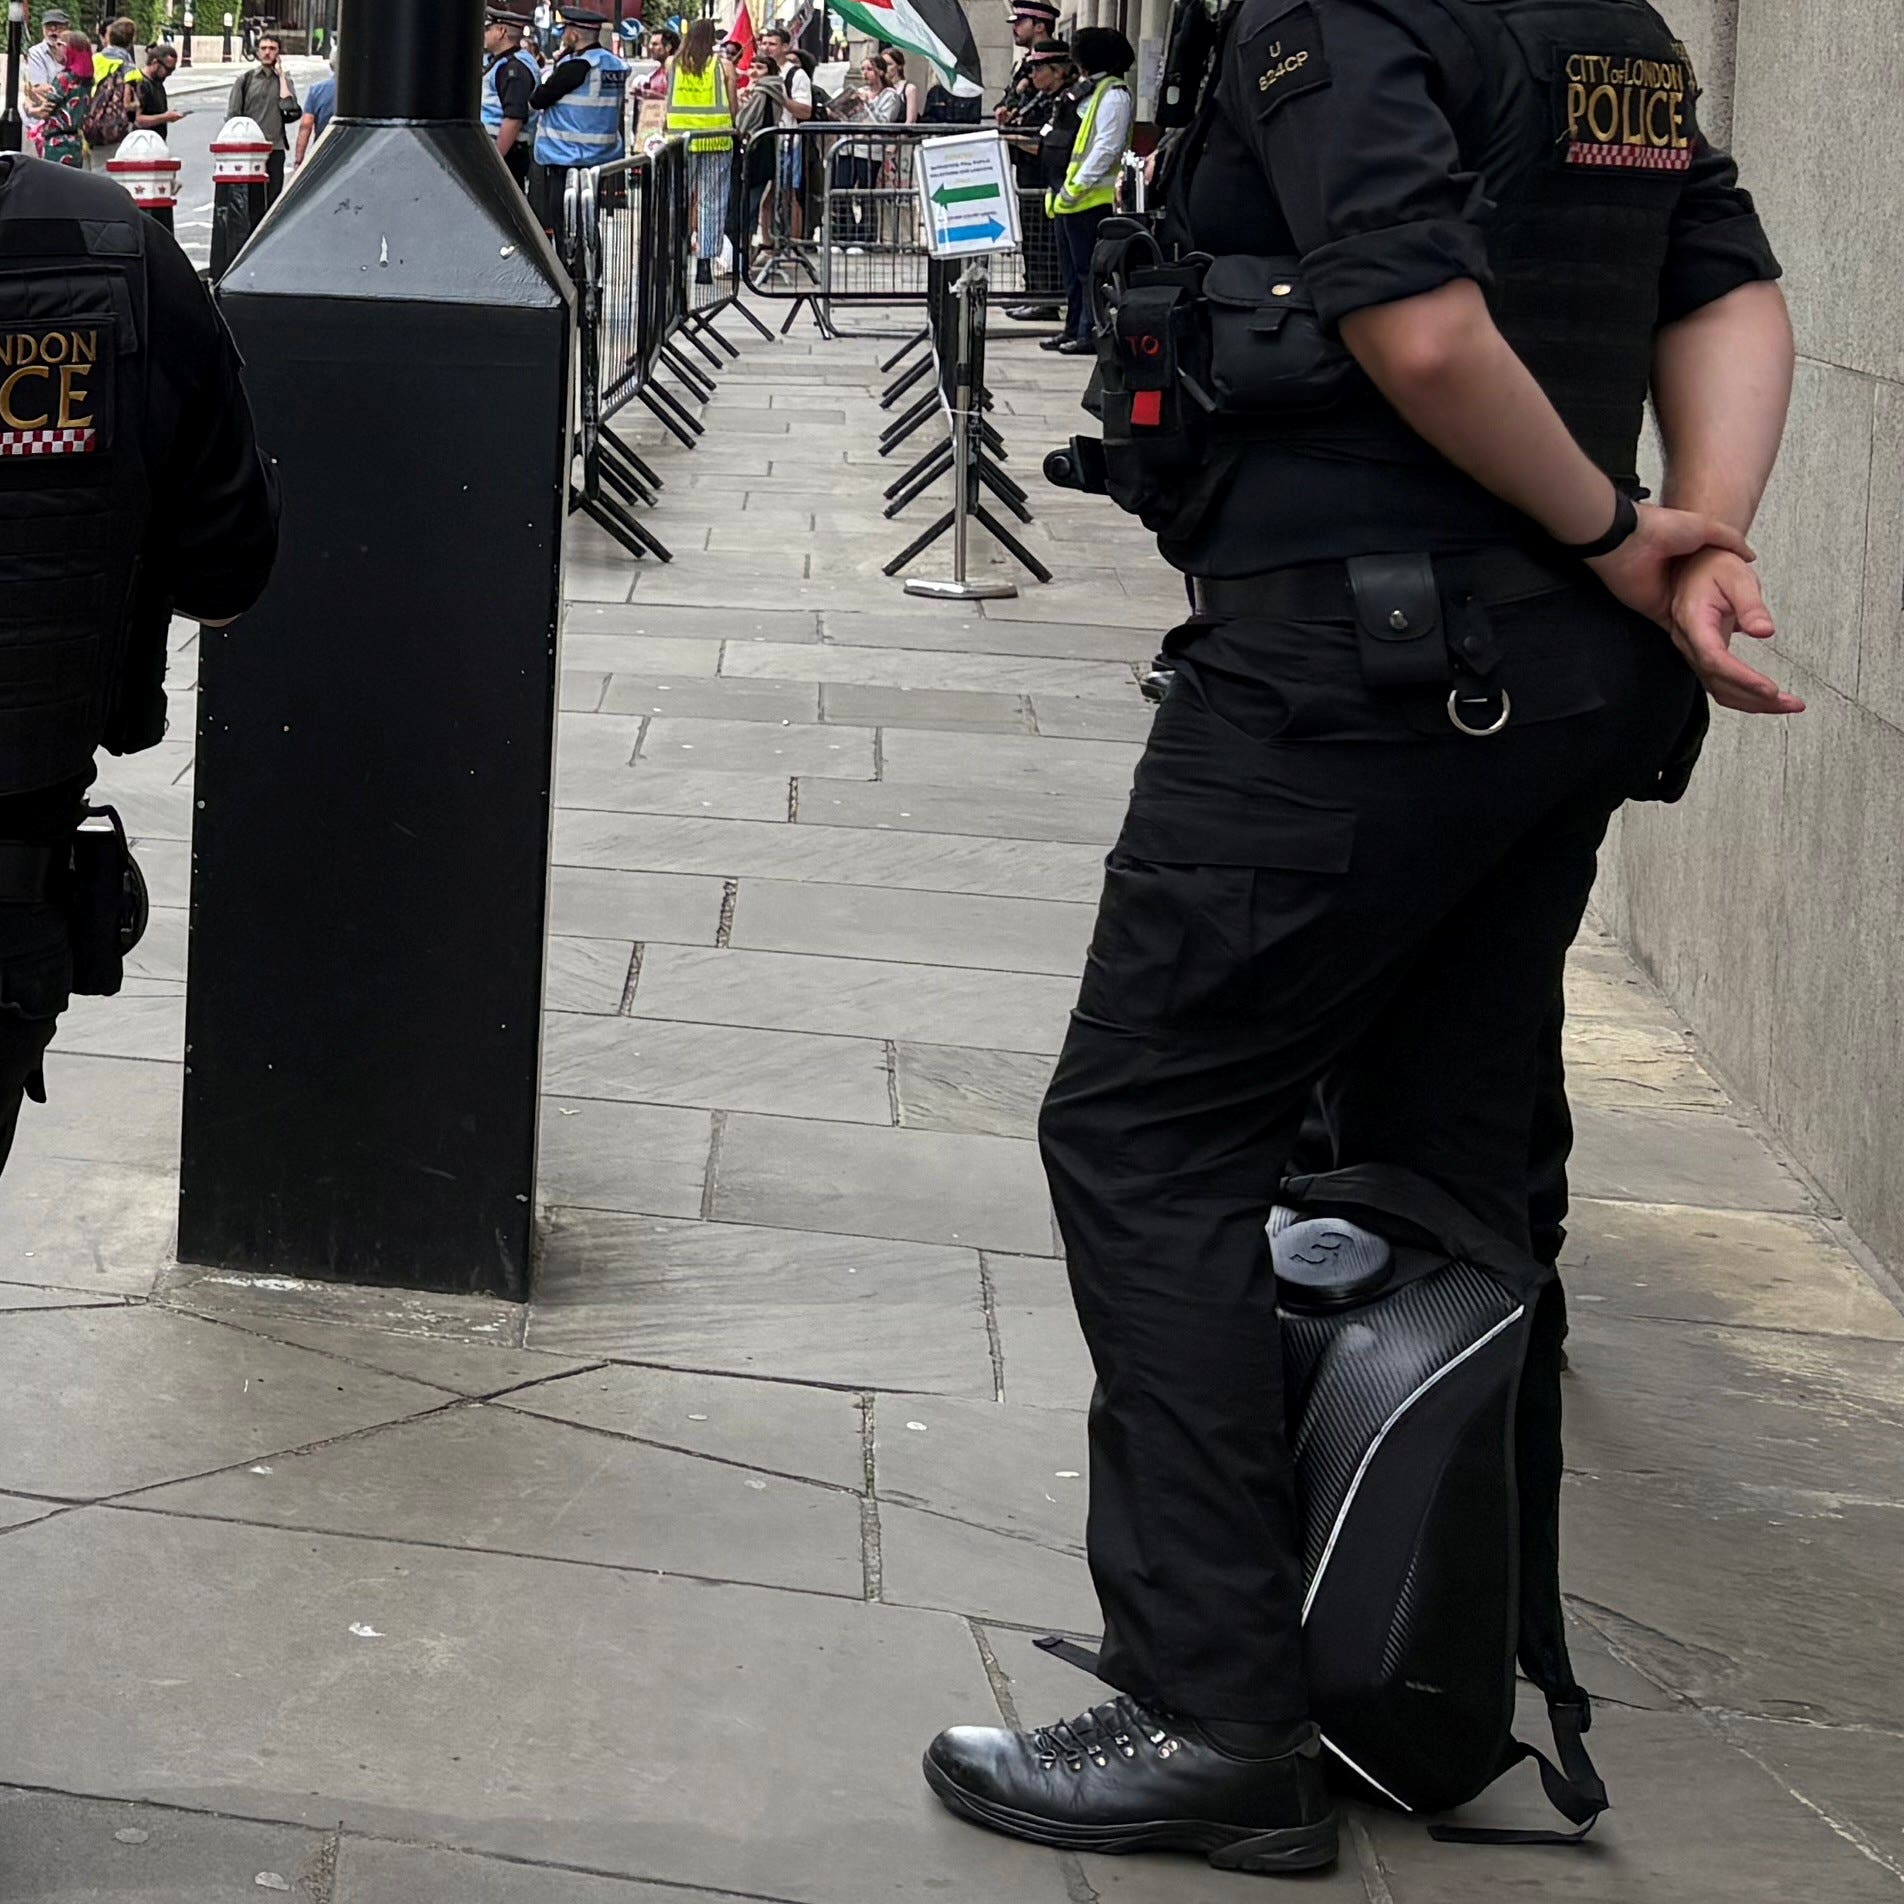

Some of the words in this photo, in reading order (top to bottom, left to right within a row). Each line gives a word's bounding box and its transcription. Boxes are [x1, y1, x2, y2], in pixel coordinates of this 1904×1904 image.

[1269, 40, 1281, 58] U
[1566, 54, 1612, 83] CITY
[1610, 69, 1625, 85] OF
[1623, 58, 1684, 90] LONDON
[1568, 83, 1688, 148] POLICE
